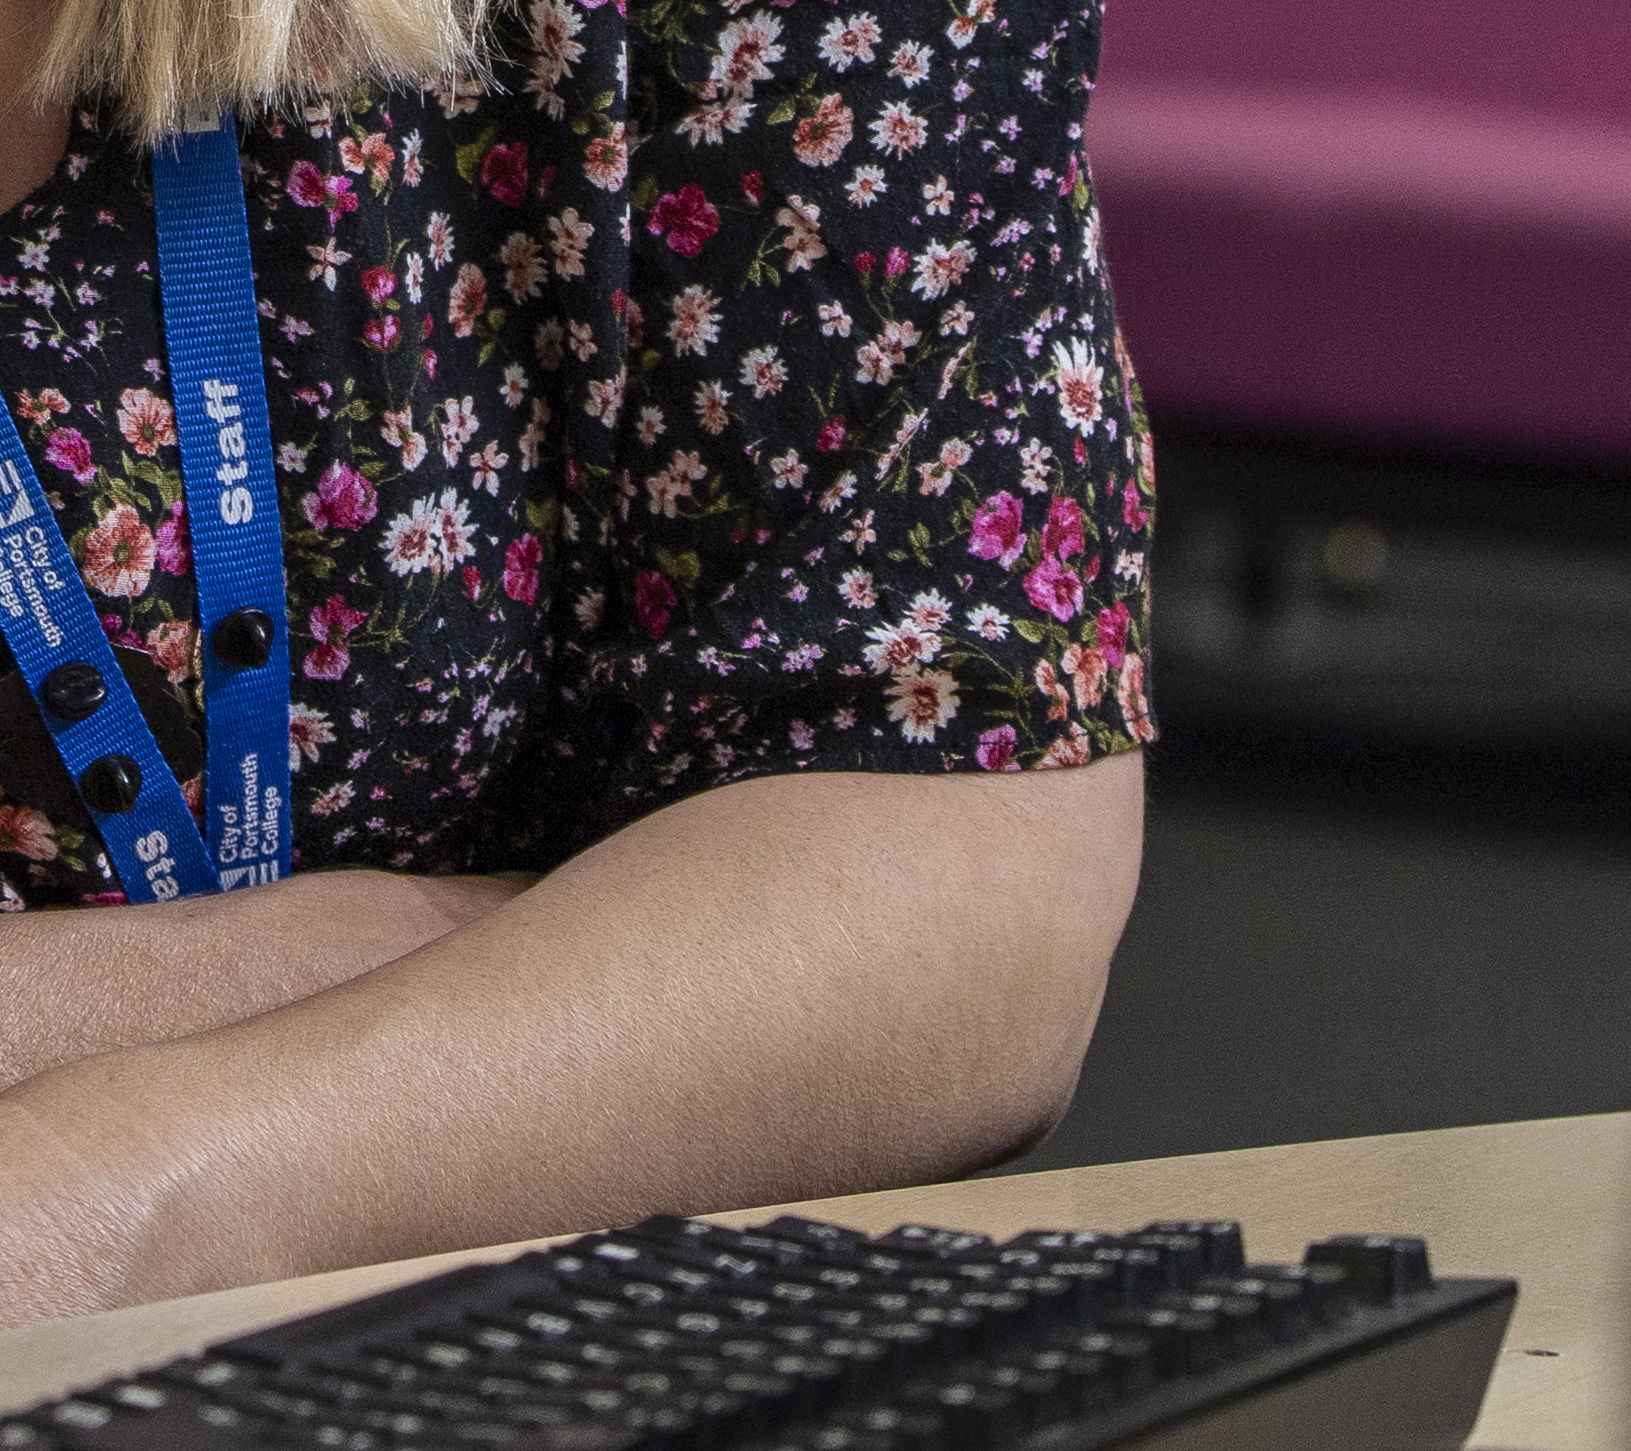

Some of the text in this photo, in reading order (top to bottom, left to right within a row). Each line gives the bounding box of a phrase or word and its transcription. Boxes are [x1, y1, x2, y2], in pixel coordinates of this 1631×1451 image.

[203, 379, 254, 525] Staff
[4, 534, 64, 648] Portsmouth
[25, 526, 66, 591] City of
[218, 804, 241, 863] City of
[240, 753, 258, 860] Portsmouth
[261, 786, 282, 855] College
[136, 830, 180, 902] Sta
